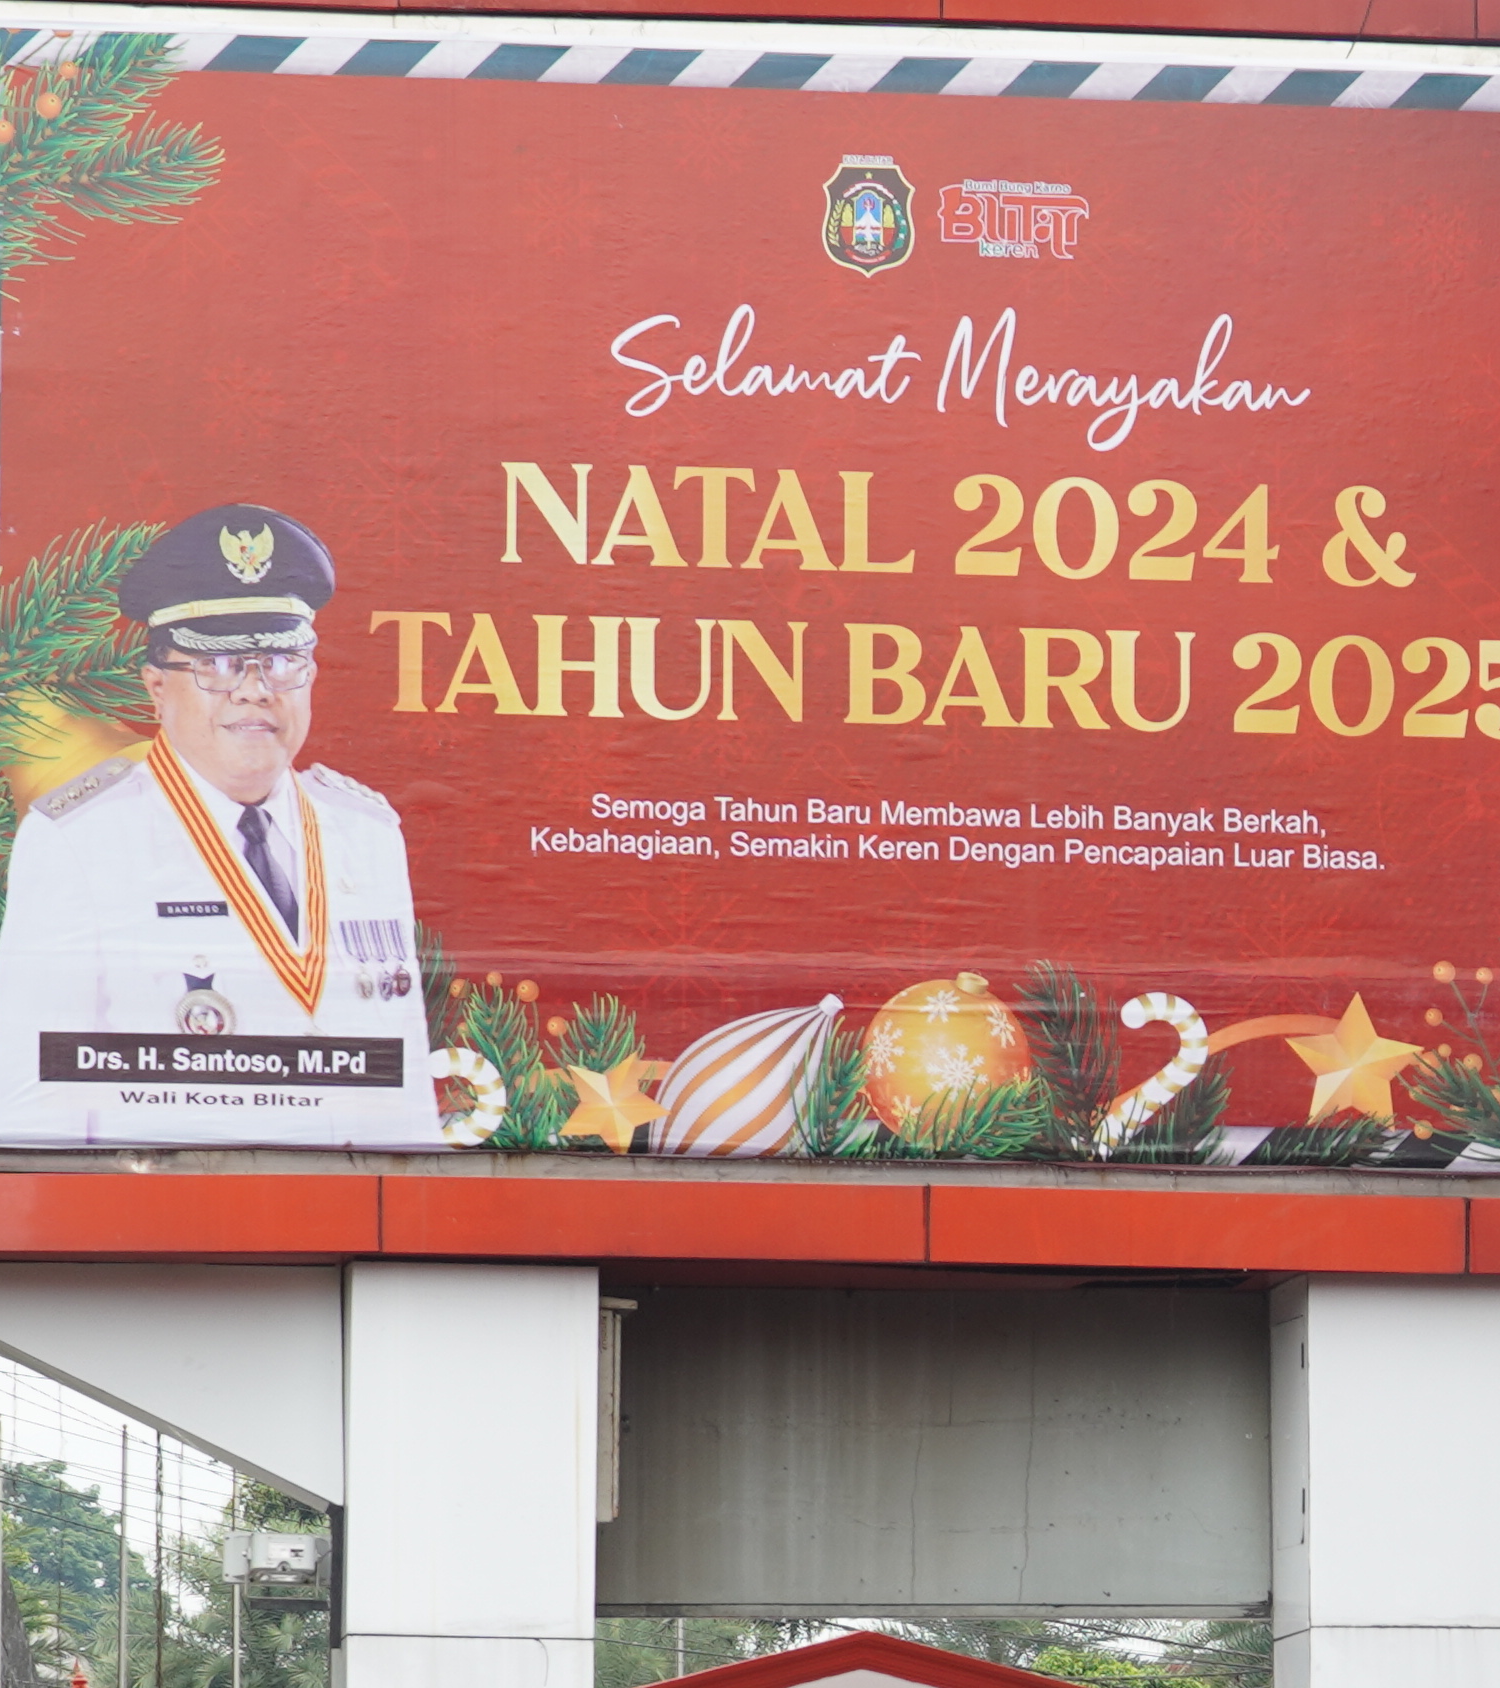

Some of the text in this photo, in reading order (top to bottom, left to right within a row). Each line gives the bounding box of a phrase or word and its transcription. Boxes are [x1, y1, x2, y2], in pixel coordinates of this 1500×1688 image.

[964, 179, 1071, 195] Bumi Bung Karno
[980, 241, 1039, 258] keren
[610, 303, 1311, 452] Selamat Merayakan
[500, 461, 1417, 589] NATAL 2024 &
[369, 610, 810, 723] TAHUN
[843, 621, 1197, 733] BARU
[591, 793, 1327, 838] Semoga Tahun Baru Membawa Lebih Banyak Berkah,
[530, 826, 1386, 871] Kebahagiaan, Semakin Keren Dengan Pencapaian Luar Biasa.
[77, 1045, 367, 1077] Drs. H. Santoso, M.Pd
[120, 1090, 324, 1107] Wali Kota Blitar
